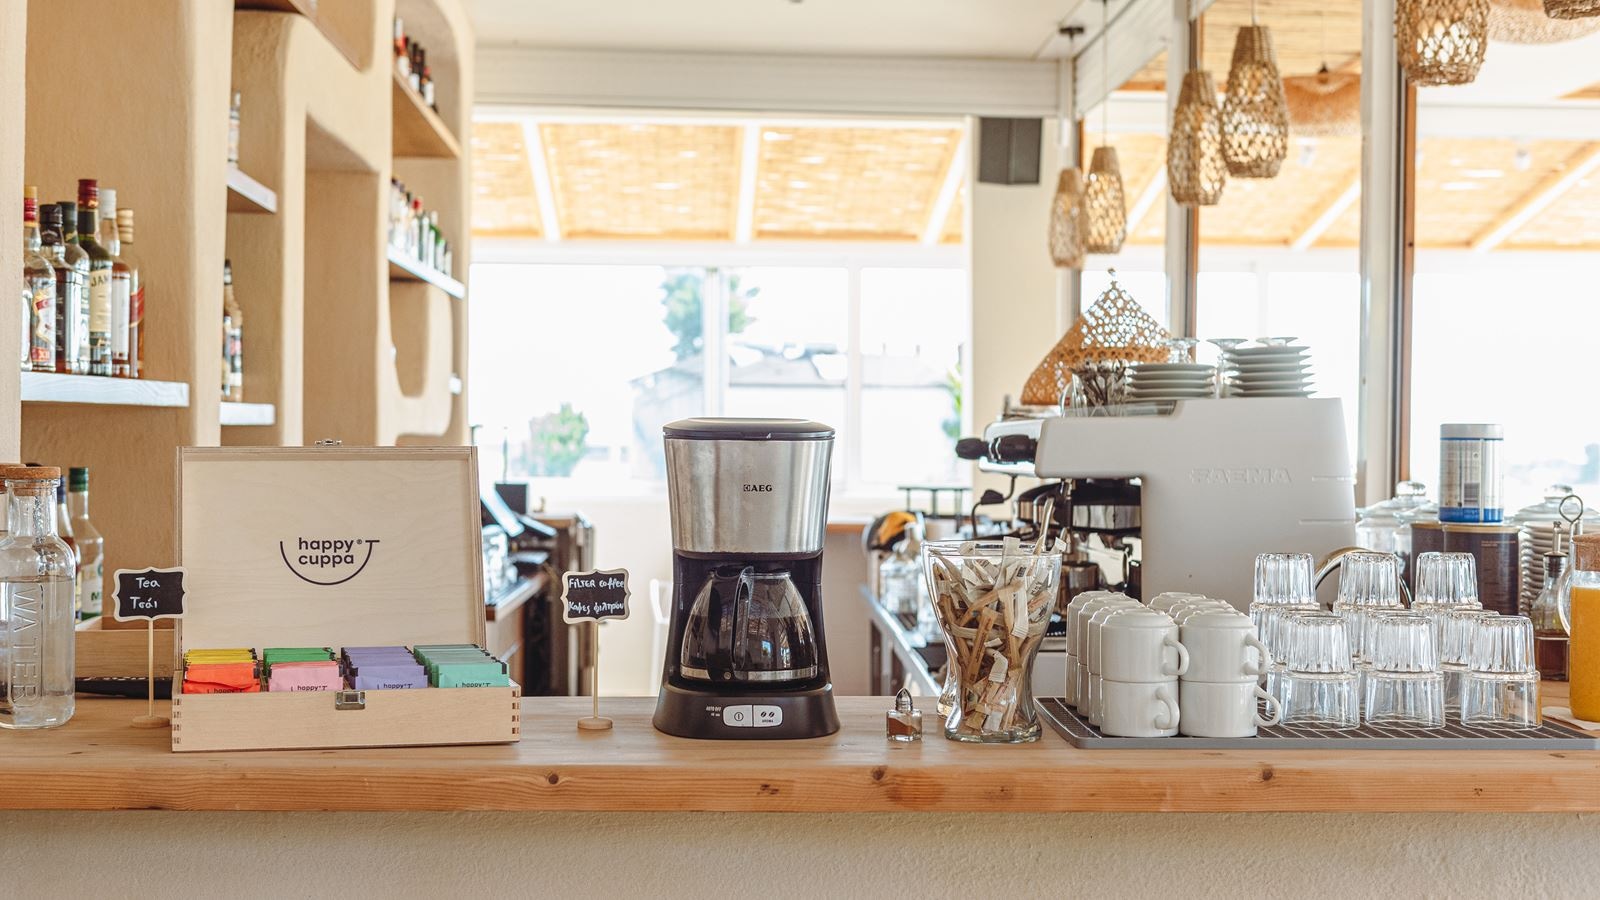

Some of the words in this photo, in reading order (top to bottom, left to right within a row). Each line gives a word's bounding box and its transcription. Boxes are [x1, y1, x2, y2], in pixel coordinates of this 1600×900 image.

[1188, 467, 1293, 484] FAEMA
[751, 484, 773, 492] AEG
[298, 537, 354, 553] happy
[298, 554, 354, 568] cuppa
[135, 577, 161, 589] Tea
[12, 587, 38, 707] WATER
[297, 684, 319, 692] happy
